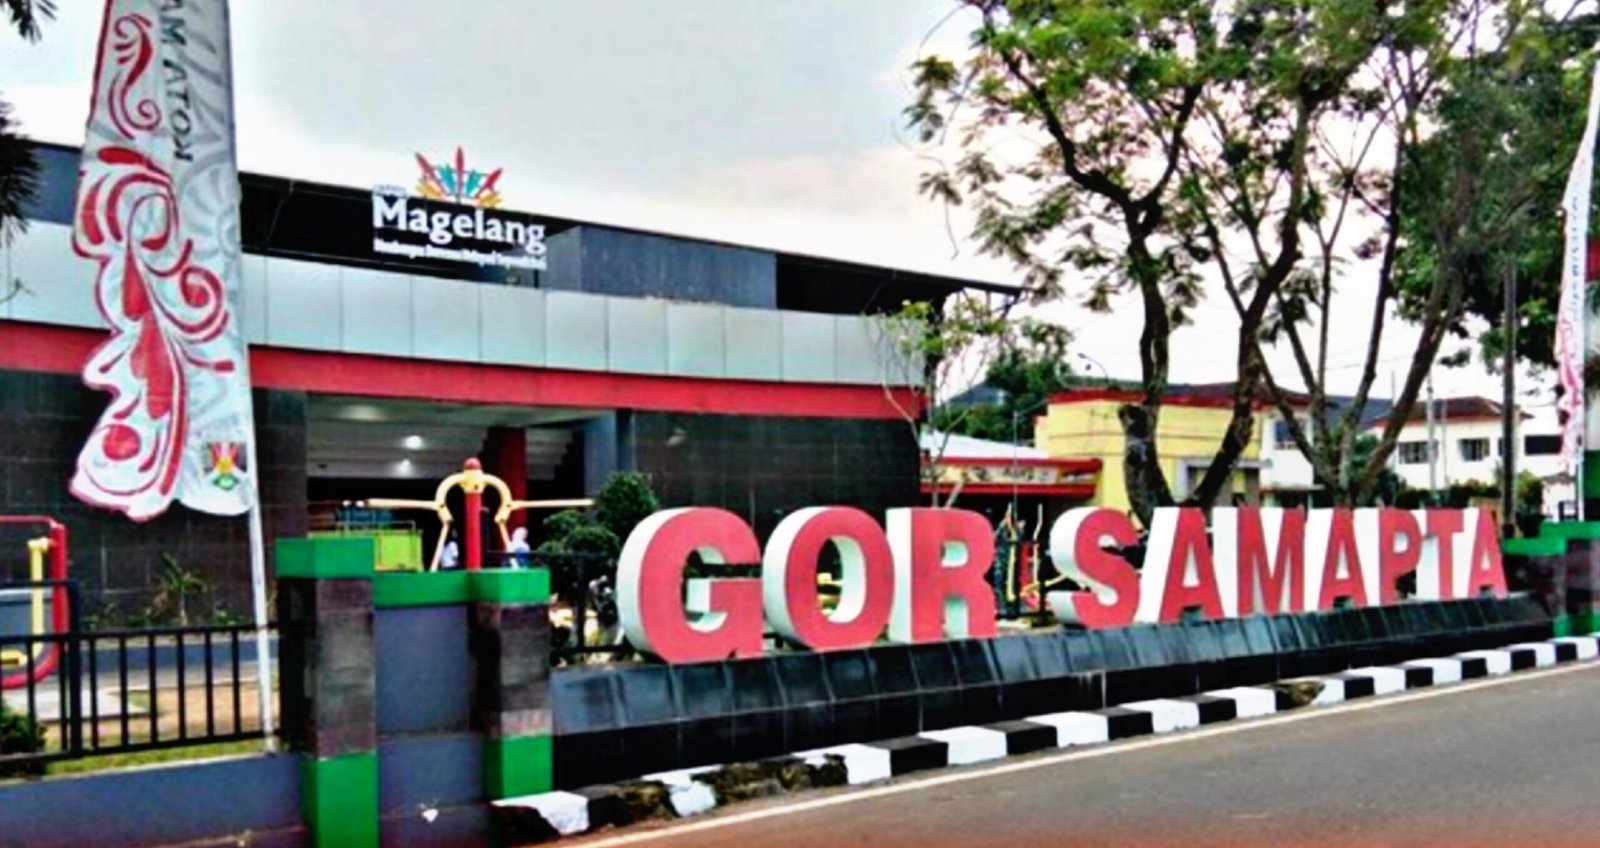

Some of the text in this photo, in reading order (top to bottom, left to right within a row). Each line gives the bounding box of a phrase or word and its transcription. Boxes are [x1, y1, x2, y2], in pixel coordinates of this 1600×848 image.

[373, 195, 547, 255] Magelang
[617, 506, 1508, 664] GOR SAMAPTA
